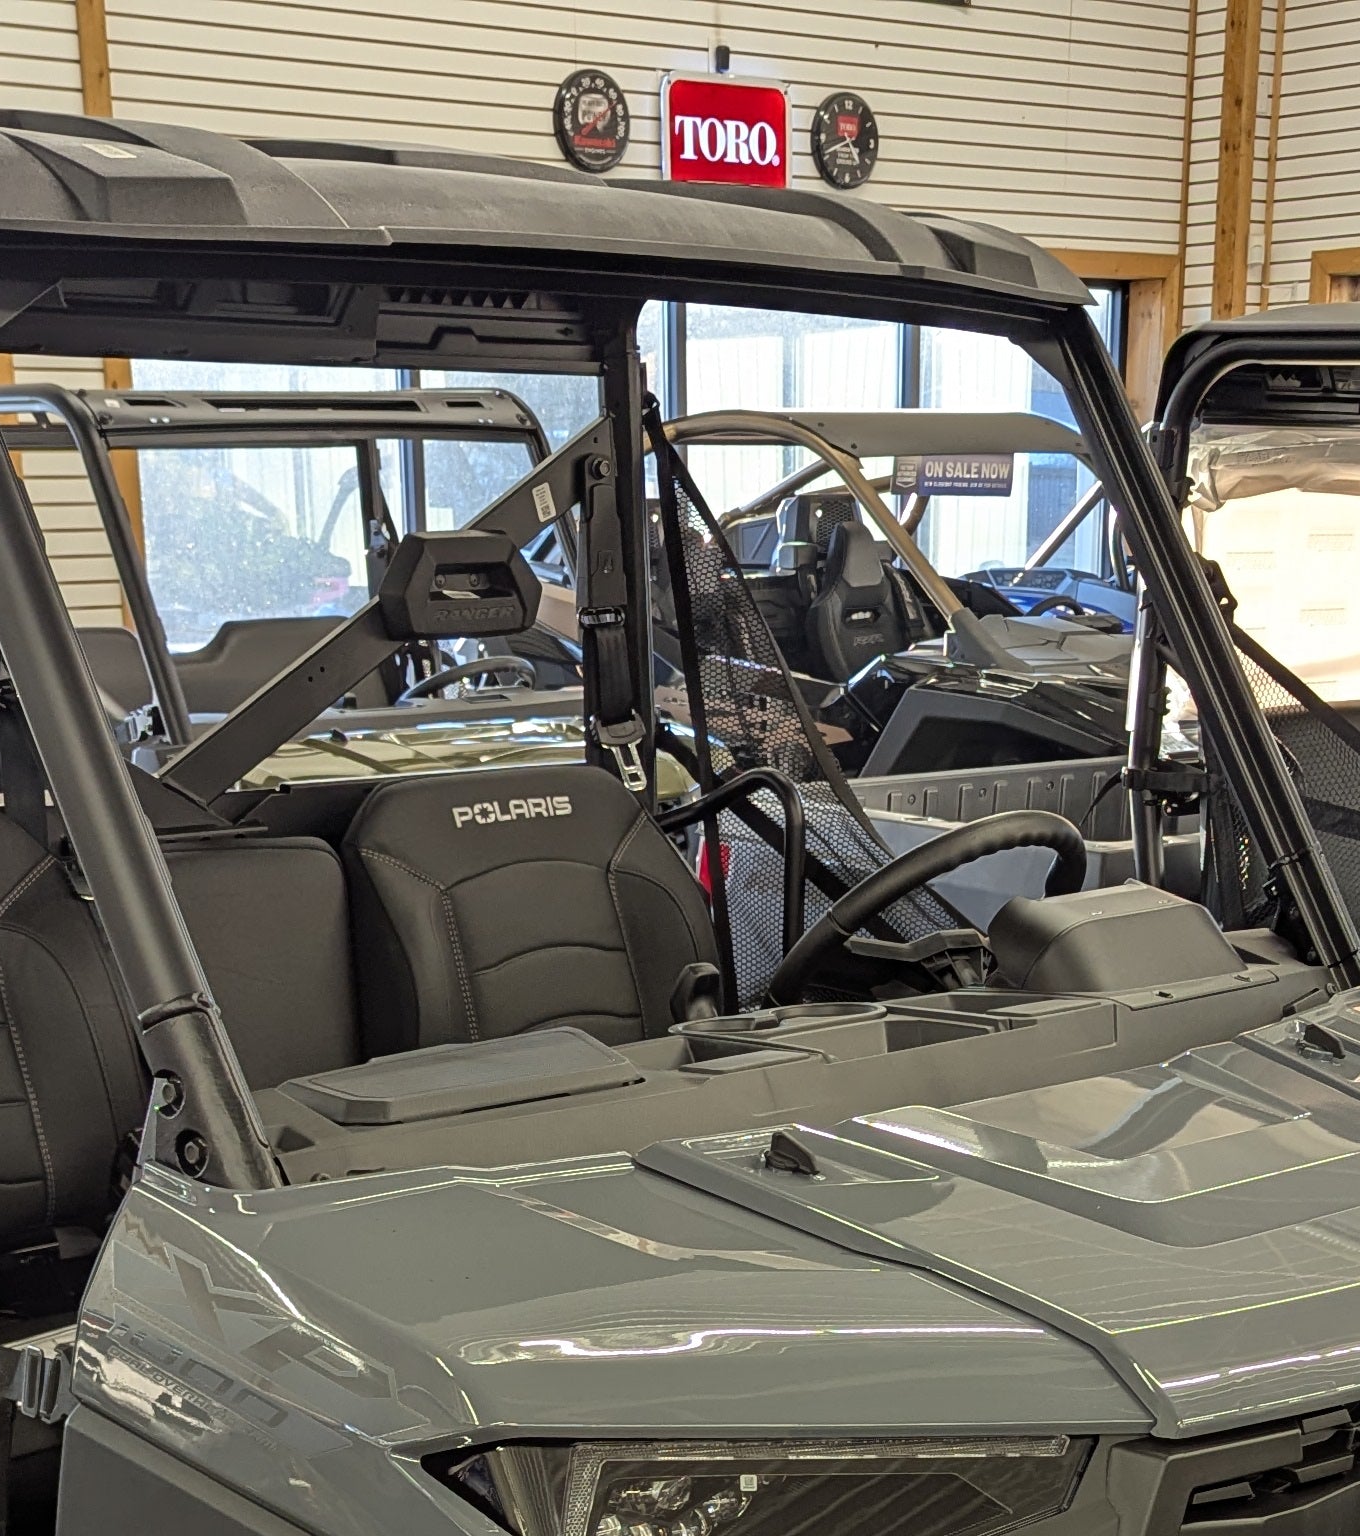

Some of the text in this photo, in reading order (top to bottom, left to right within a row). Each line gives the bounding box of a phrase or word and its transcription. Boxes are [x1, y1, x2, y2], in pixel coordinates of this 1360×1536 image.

[674, 114, 776, 166] TORO
[925, 461, 1010, 479] ON SALE NOW
[452, 794, 572, 829] POLARIS
